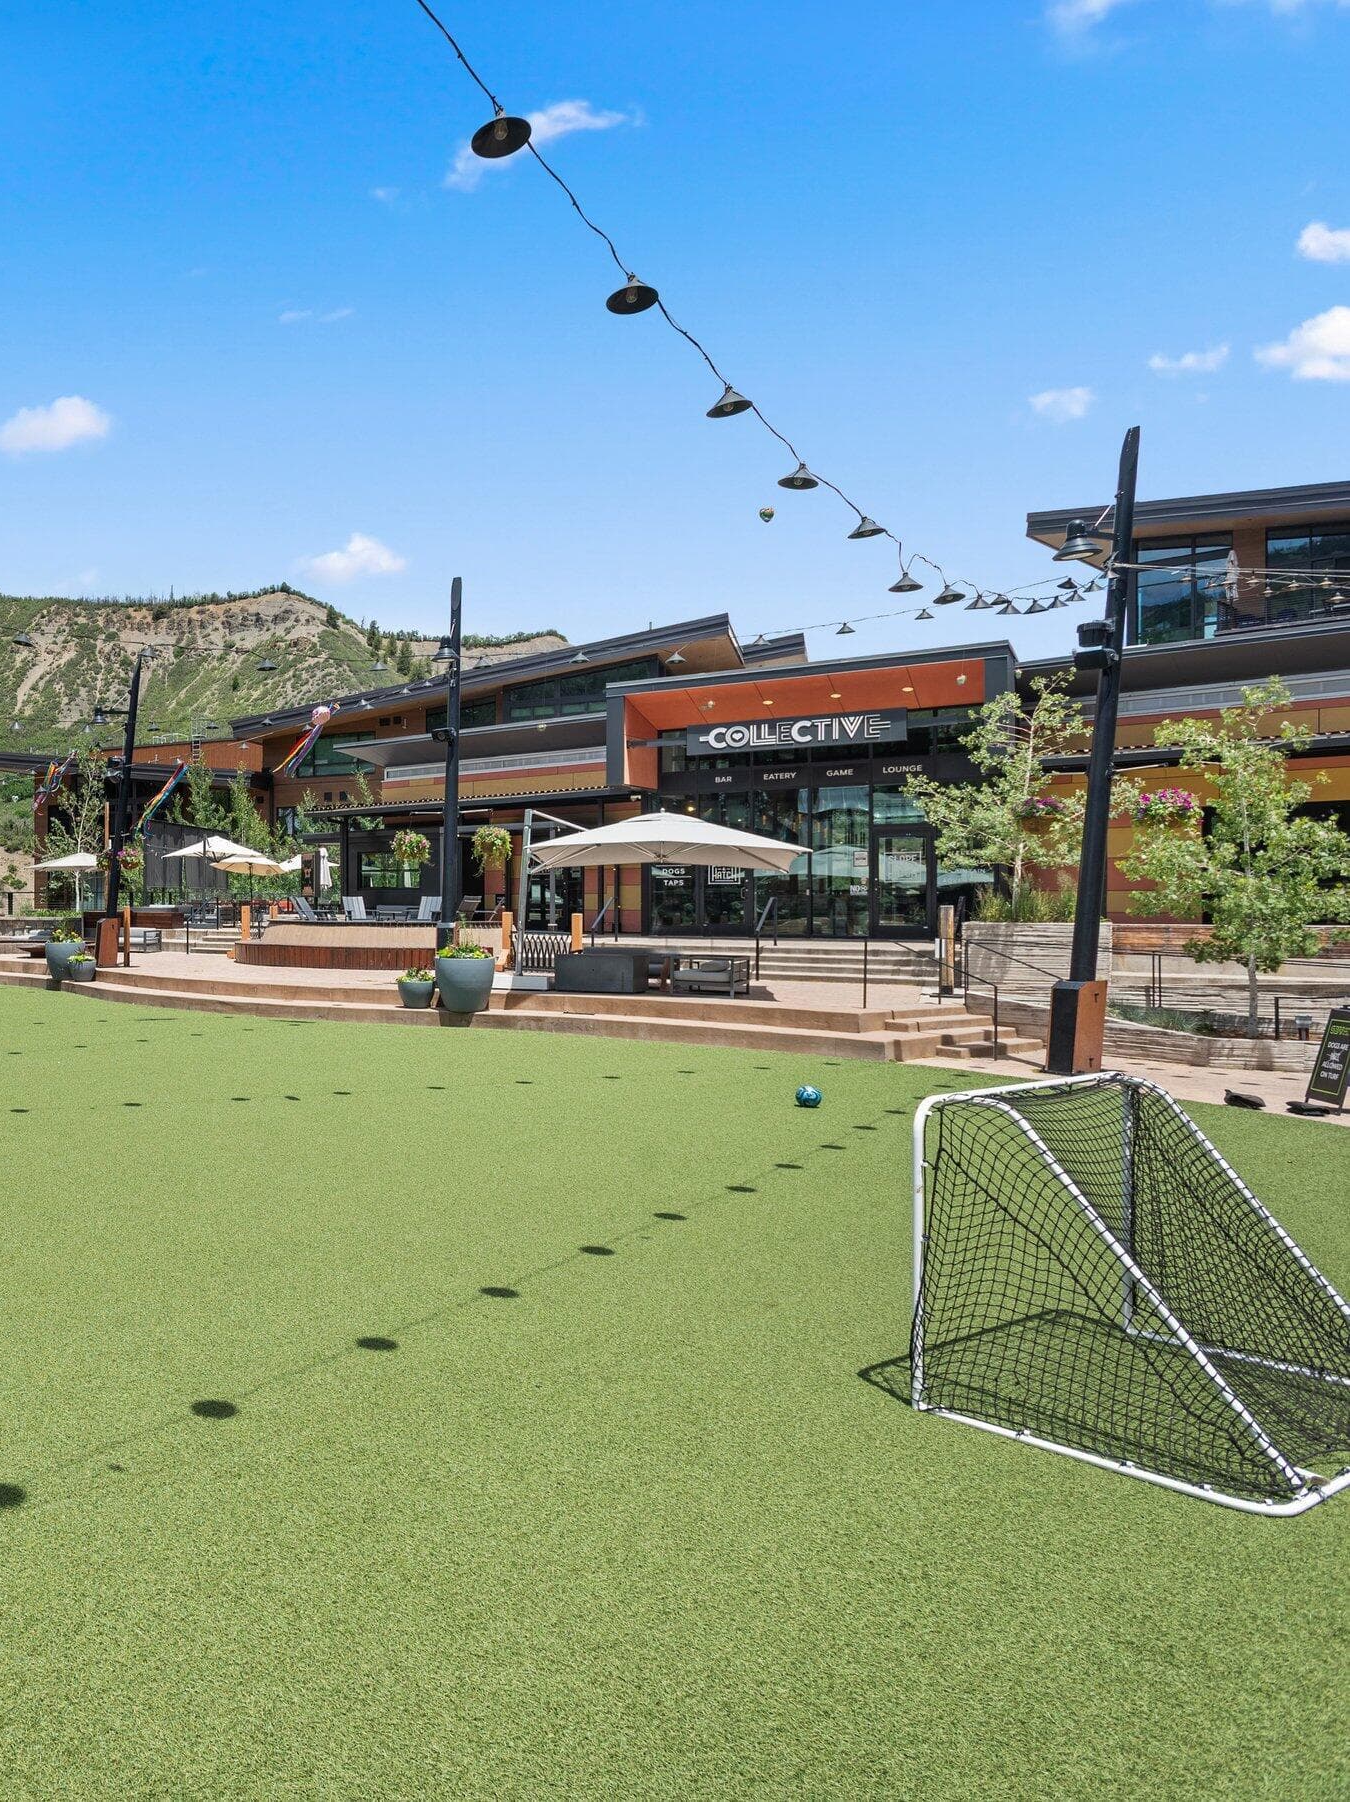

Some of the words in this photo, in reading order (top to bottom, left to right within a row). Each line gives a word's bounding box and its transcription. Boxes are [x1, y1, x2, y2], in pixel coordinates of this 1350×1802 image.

[699, 714, 891, 749] COLLECTIVE
[826, 768, 854, 777] GAME
[882, 764, 923, 774] LOUNGE
[714, 775, 733, 784] BAR
[763, 772, 797, 780] EATERY
[663, 879, 685, 887] TAPS
